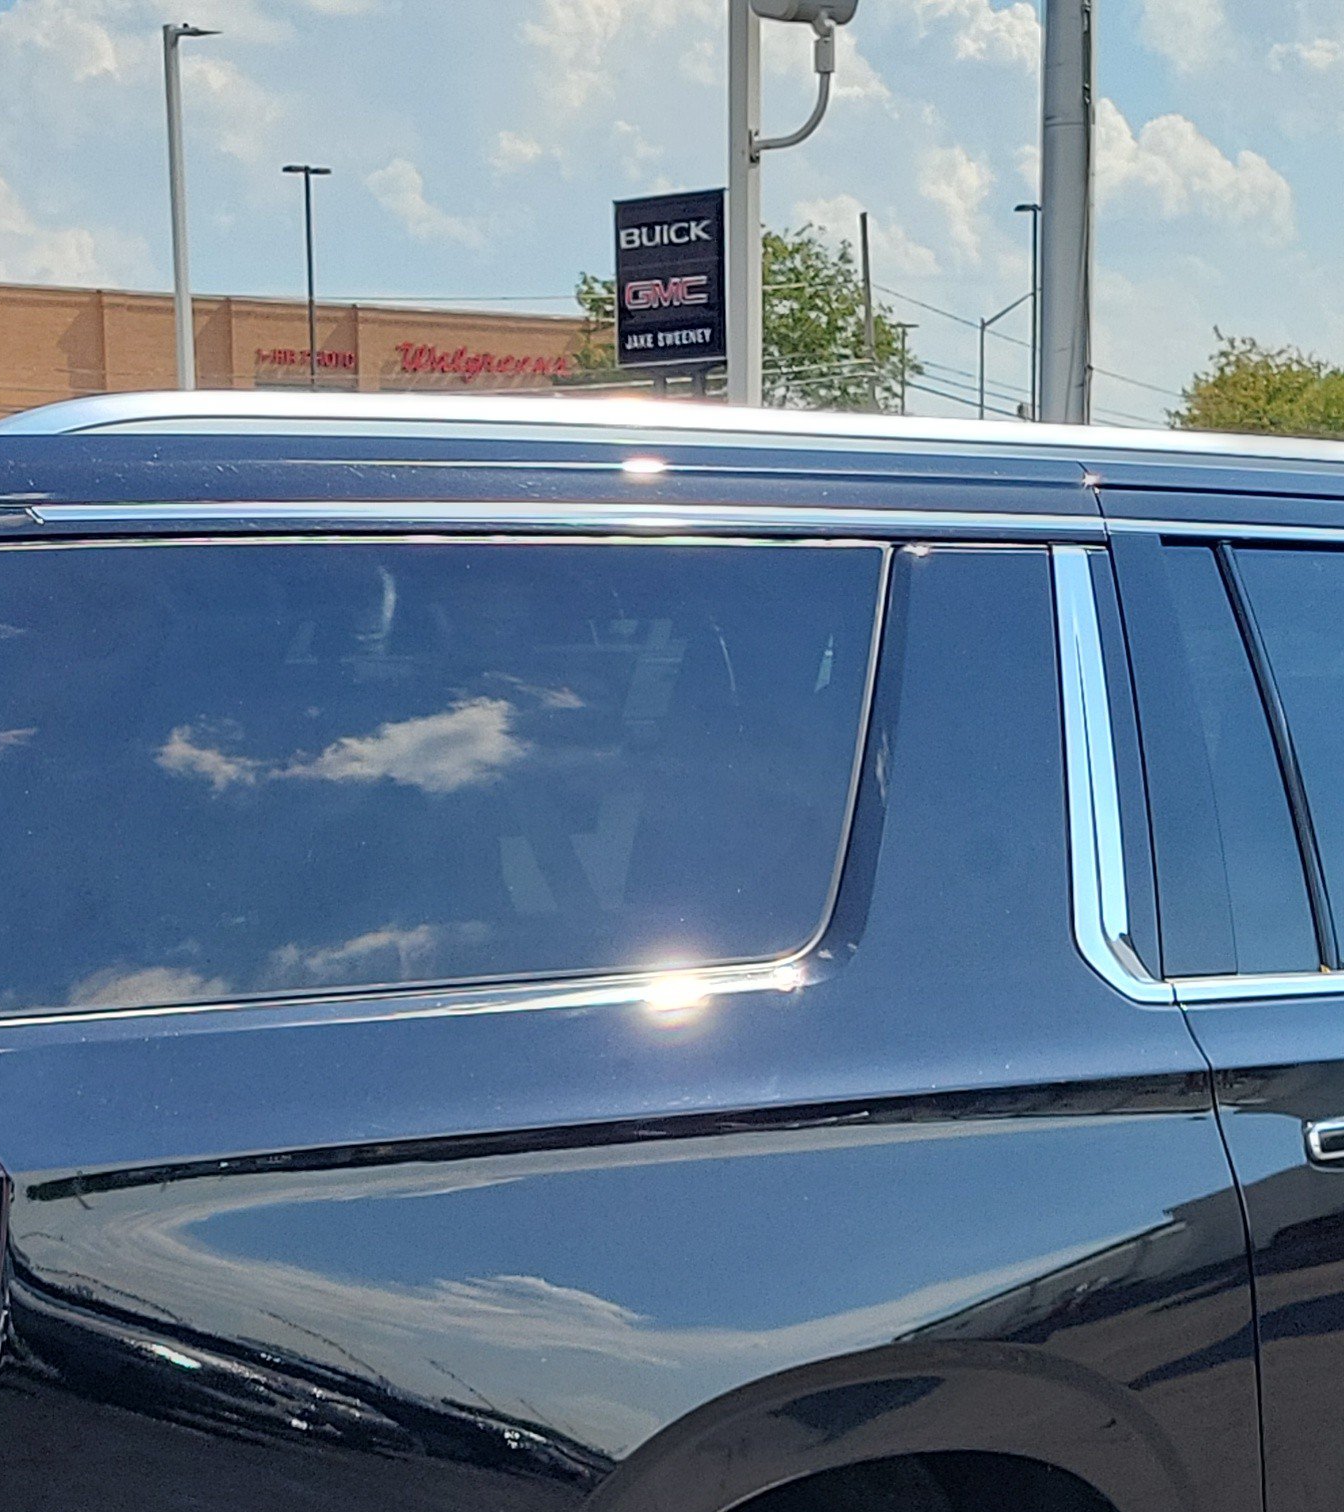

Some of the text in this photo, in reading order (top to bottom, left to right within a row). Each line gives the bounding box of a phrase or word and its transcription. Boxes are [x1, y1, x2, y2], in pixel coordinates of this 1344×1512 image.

[619, 220, 713, 250] BUICK
[625, 275, 709, 310] GMC
[625, 328, 713, 350] JAKE SWEENEY
[395, 341, 573, 384] Walgreens
